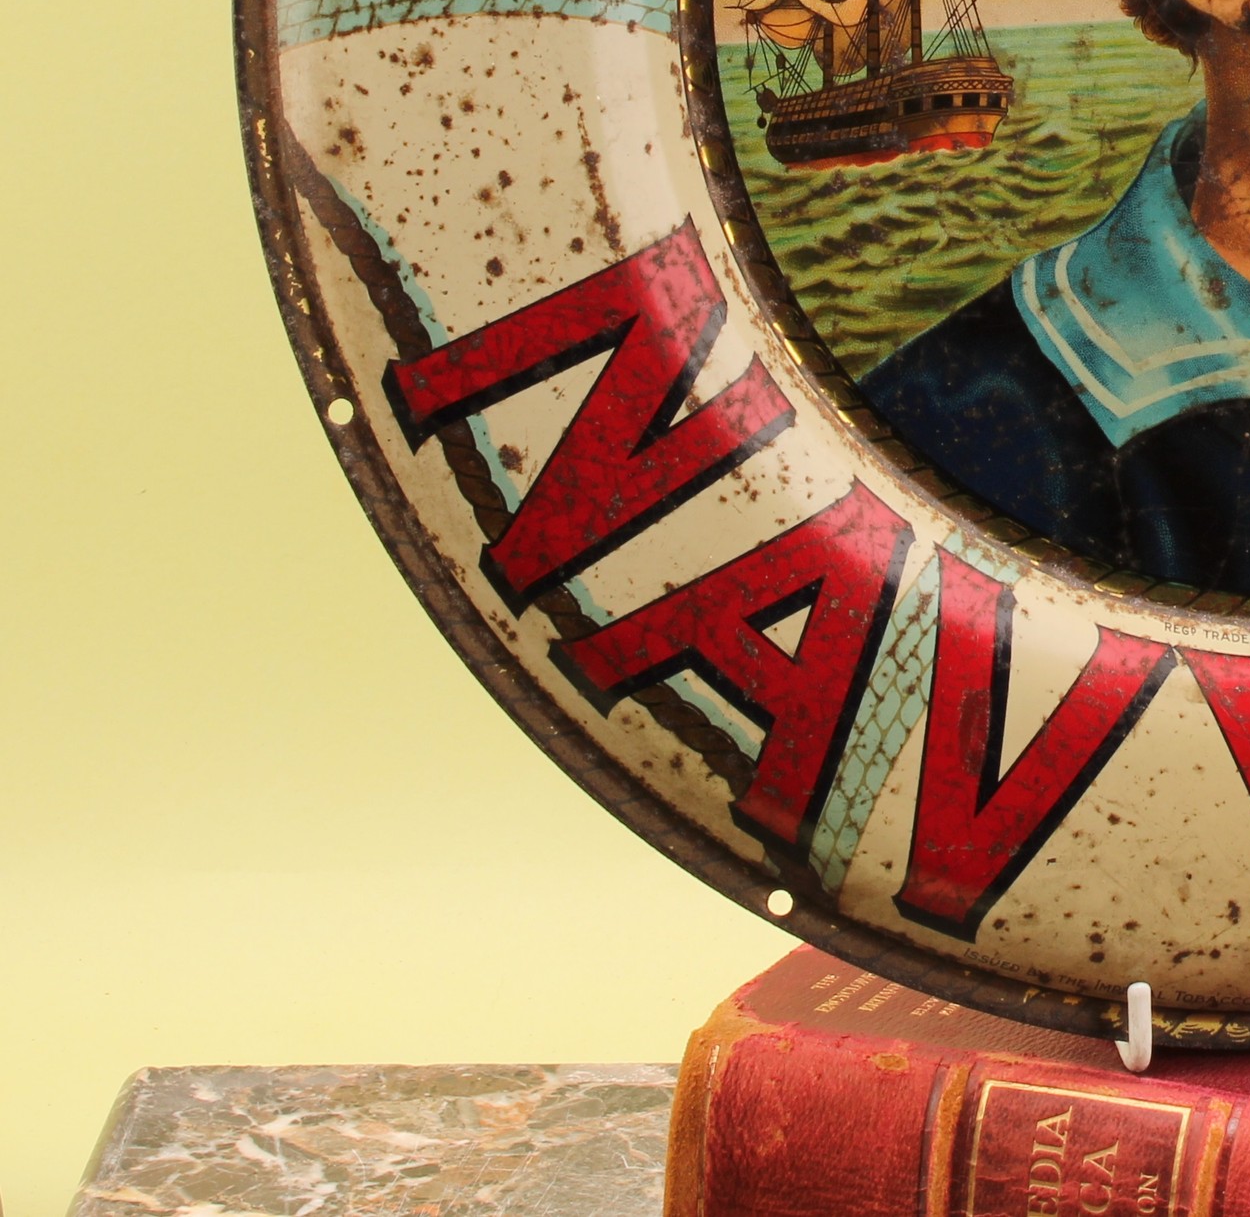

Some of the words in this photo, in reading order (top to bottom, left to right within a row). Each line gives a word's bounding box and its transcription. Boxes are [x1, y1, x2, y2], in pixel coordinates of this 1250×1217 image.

[1203, 629, 1250, 644] TRADE
[964, 947, 1020, 972] ISSUED
[1058, 974, 1087, 989] THE
